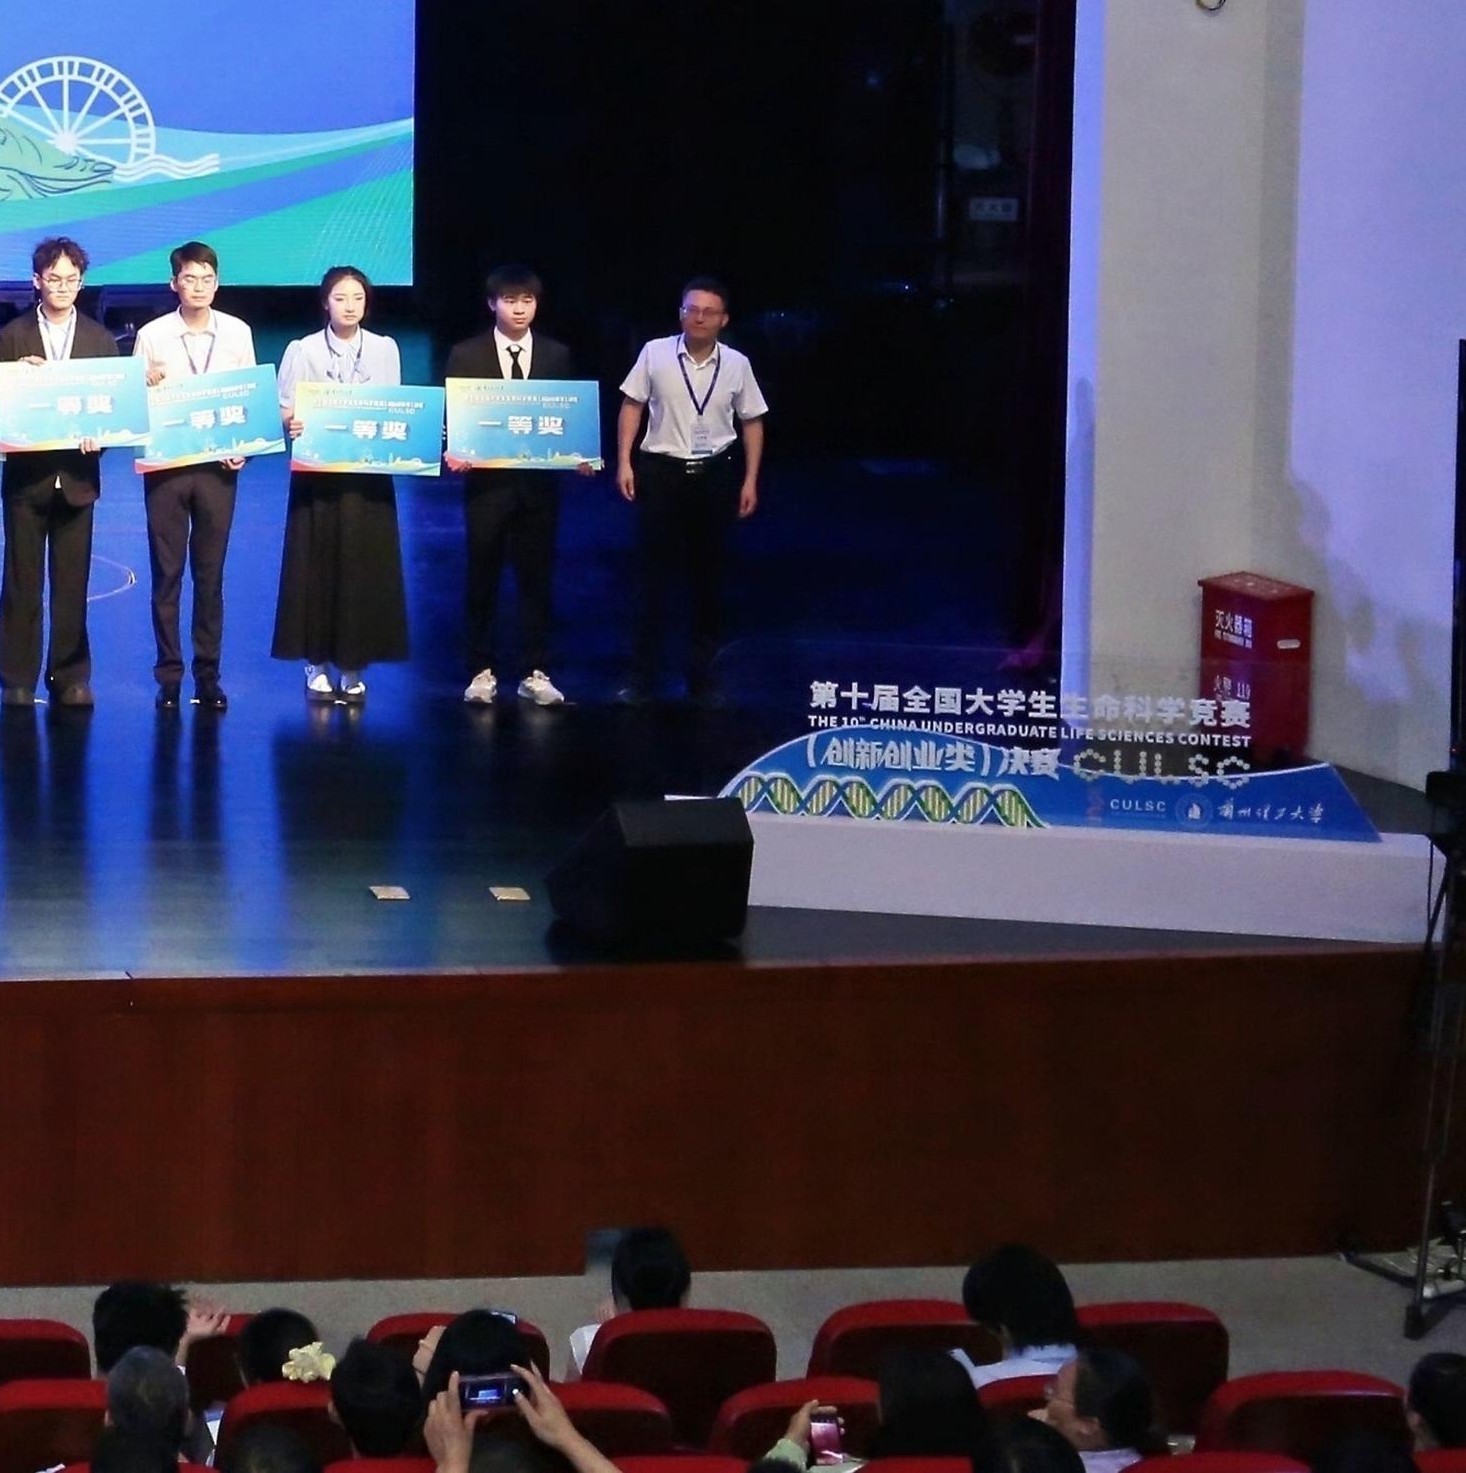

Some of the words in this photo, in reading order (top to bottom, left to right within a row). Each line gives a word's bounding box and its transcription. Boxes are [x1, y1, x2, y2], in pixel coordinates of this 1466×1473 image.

[163, 406, 246, 429] 一等奖
[478, 416, 563, 435] 一等奖
[325, 420, 408, 440] 一等奖
[810, 681, 1250, 728] 第十届全国大学生生命科学竞赛
[808, 715, 837, 727] THE
[870, 718, 919, 731] CHINA
[921, 720, 1057, 739] UNDERGRADUATE
[1061, 727, 1094, 740] LIFE
[1097, 729, 1174, 744] SCIENCES
[1178, 733, 1251, 747] CONTEST
[1073, 748, 1250, 790] CULSC
[1110, 799, 1167, 812] CULSC
